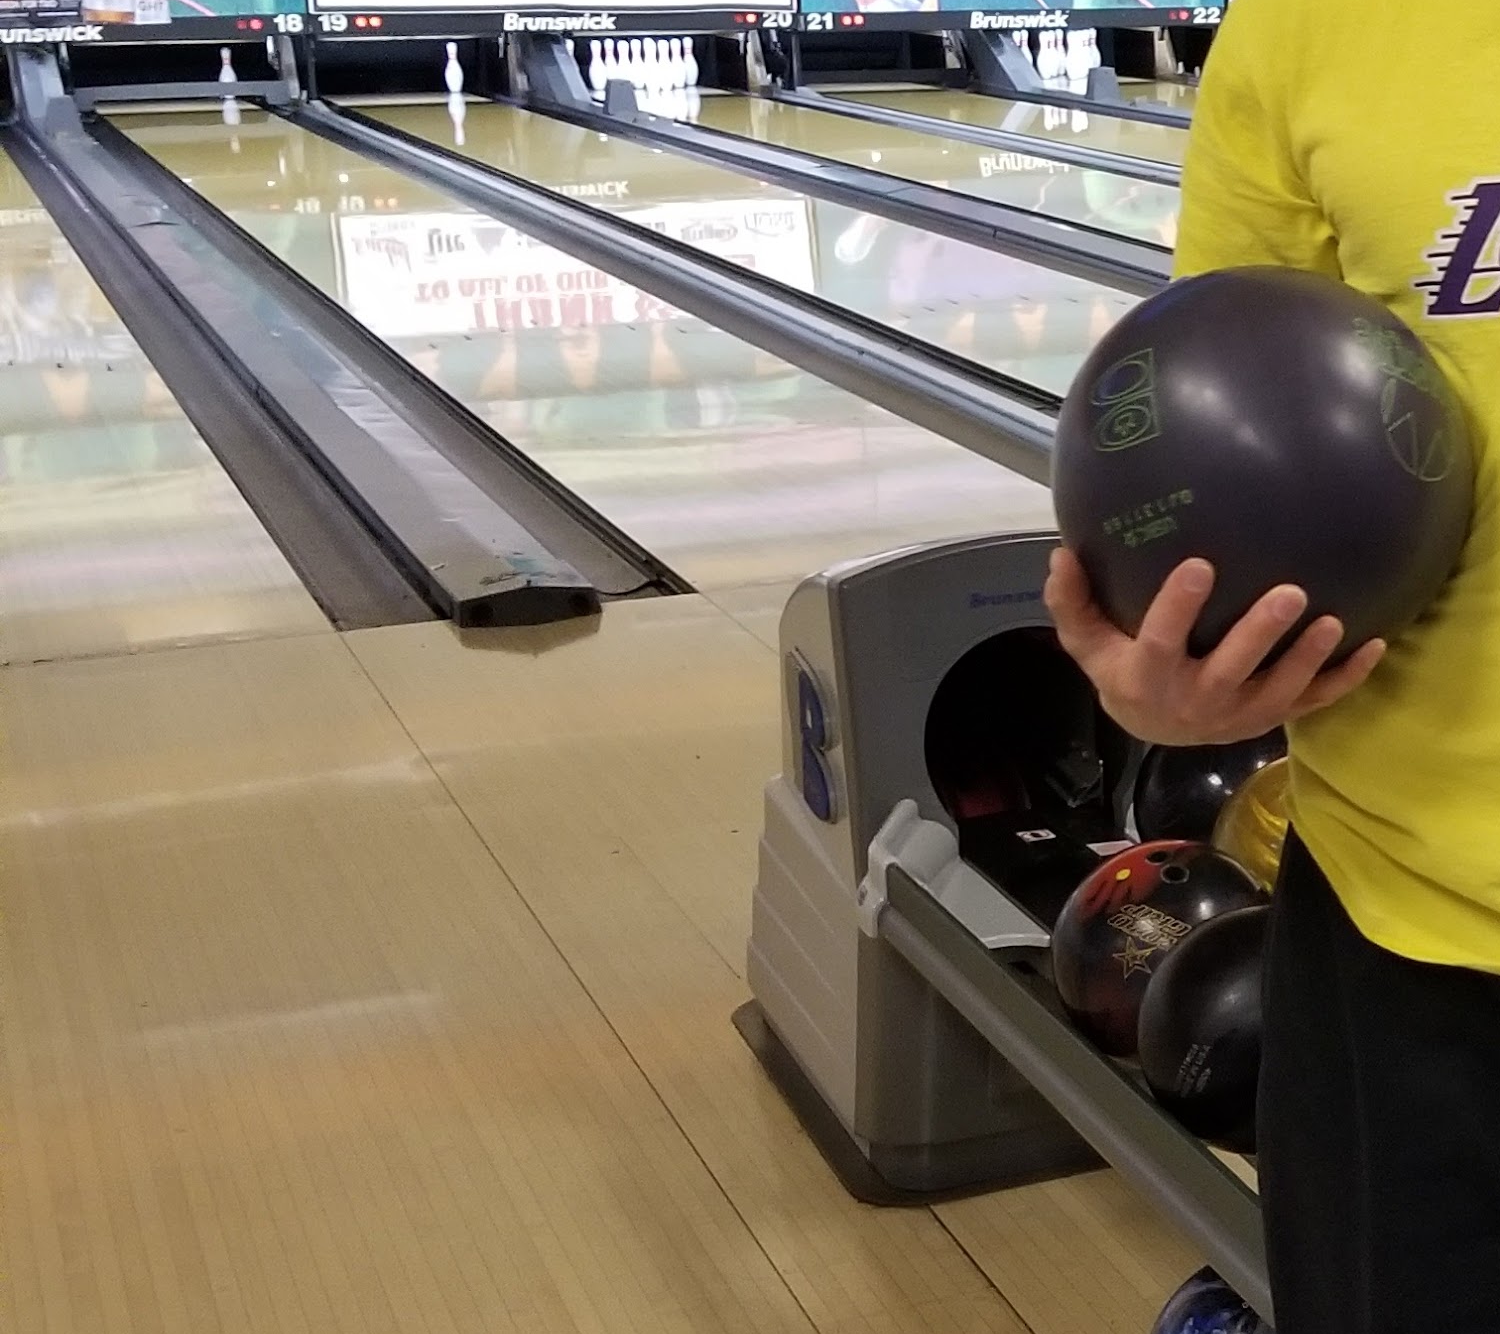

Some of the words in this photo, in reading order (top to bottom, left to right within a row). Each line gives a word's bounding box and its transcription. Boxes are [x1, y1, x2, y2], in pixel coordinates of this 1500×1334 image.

[317, 14, 349, 32] 19
[503, 11, 617, 32] Brunswick
[762, 12, 794, 28] 20
[806, 12, 835, 30] 21
[970, 9, 1070, 29] Brunswick
[1192, 6, 1221, 24] 22
[272, 15, 303, 34] 18
